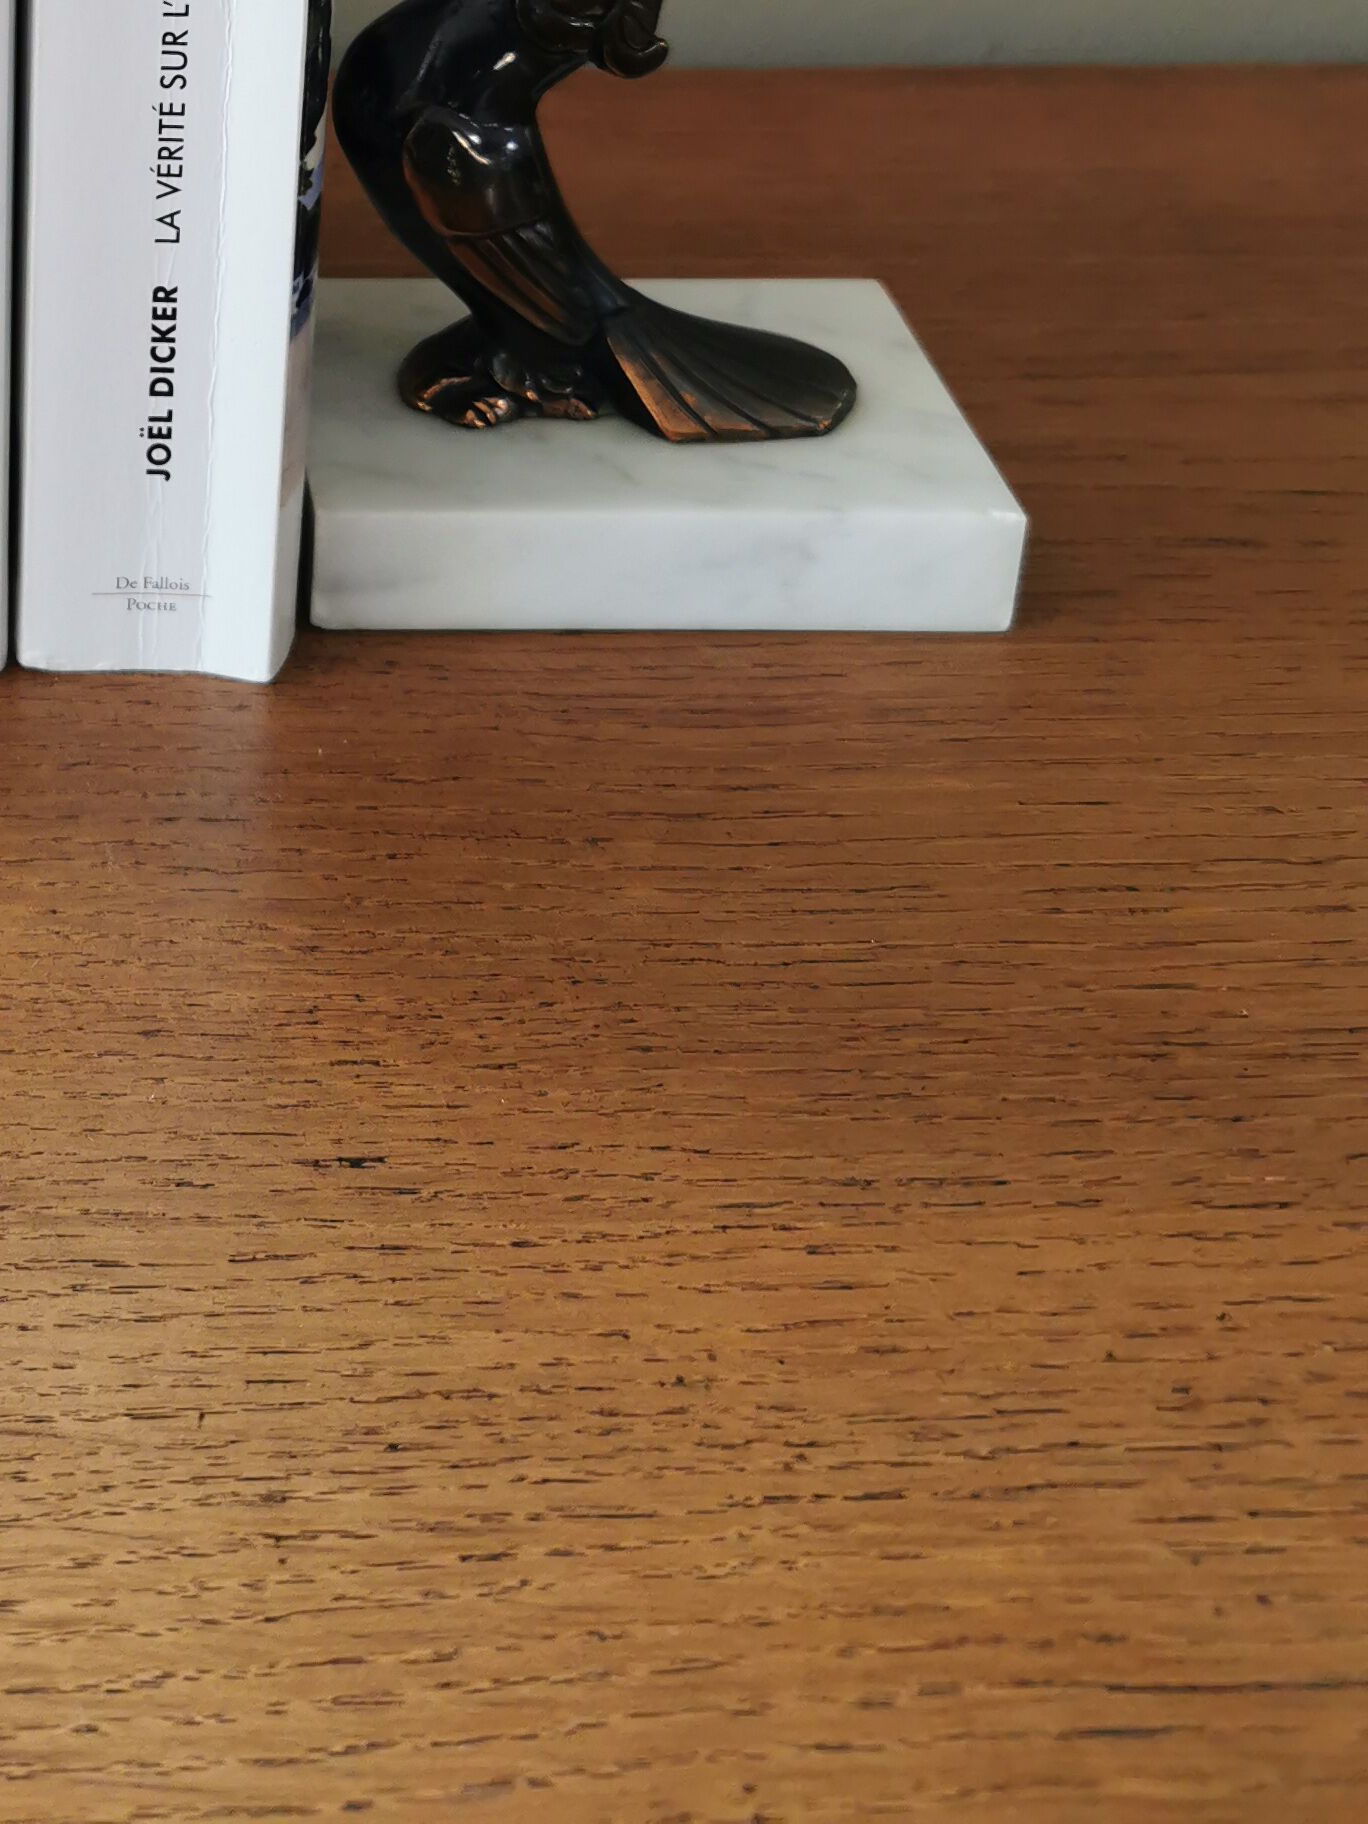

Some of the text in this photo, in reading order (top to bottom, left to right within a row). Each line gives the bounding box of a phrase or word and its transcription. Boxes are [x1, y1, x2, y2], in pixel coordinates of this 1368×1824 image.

[159, 30, 189, 91] SUR
[149, 102, 186, 199] VÉRITÉ
[154, 210, 181, 244] LA
[137, 286, 179, 483] JOËL DICKER
[115, 576, 190, 591] De Fallois
